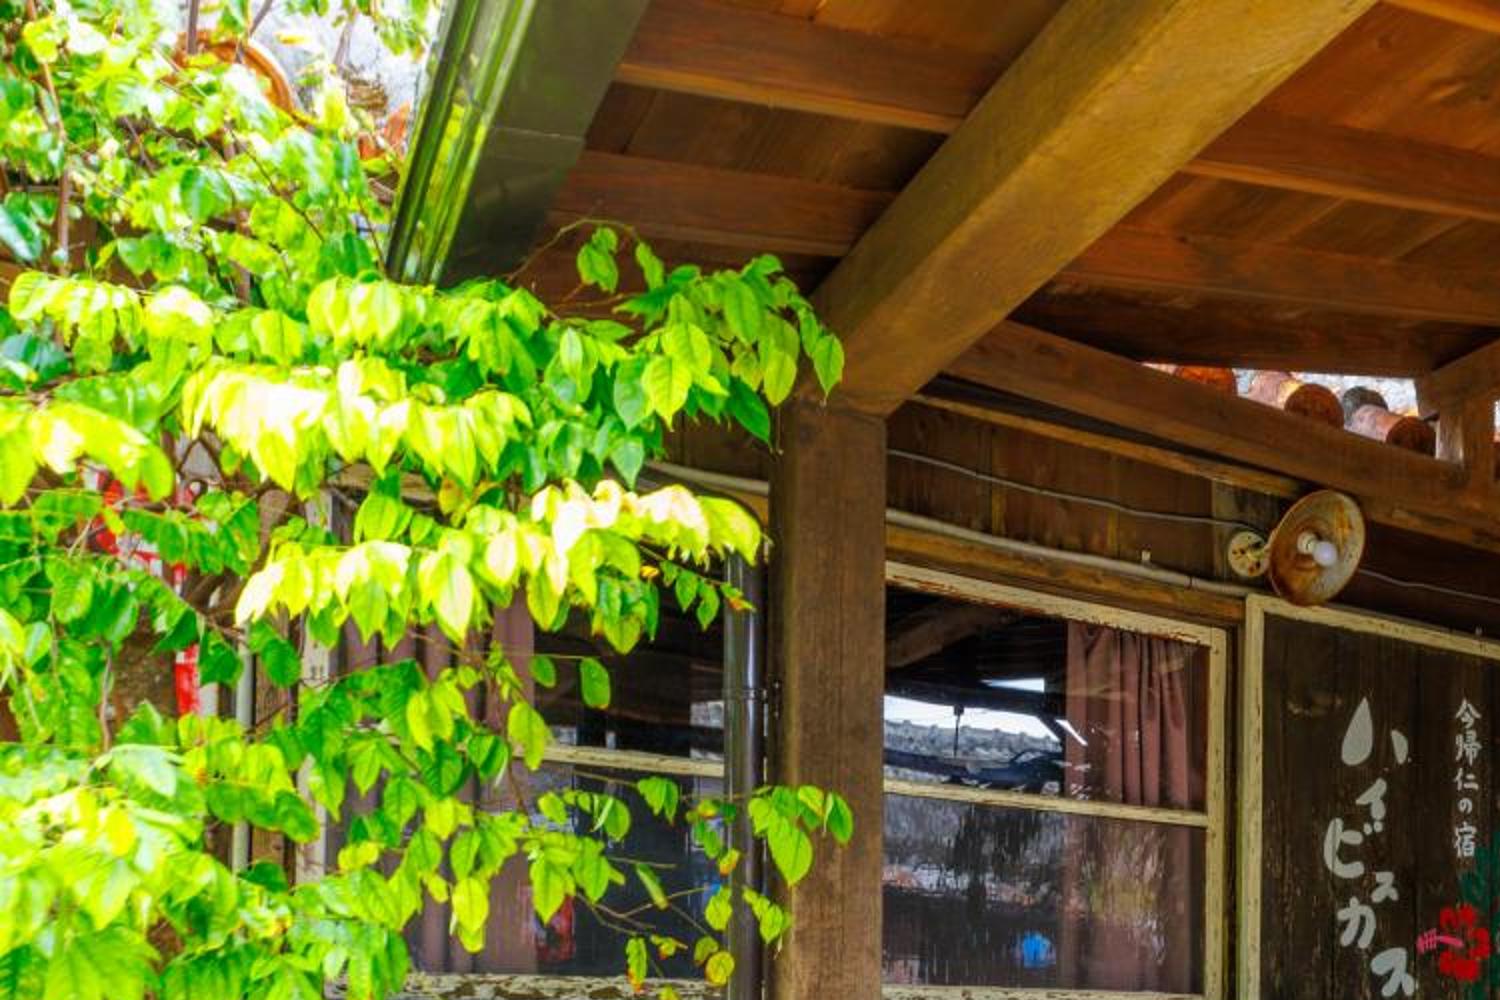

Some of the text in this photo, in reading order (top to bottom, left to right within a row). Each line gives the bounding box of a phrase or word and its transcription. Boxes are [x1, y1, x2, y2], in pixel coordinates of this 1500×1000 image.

[1322, 696, 1418, 998] ハイビスカス
[1454, 698, 1482, 859] 今帰仁の宿
